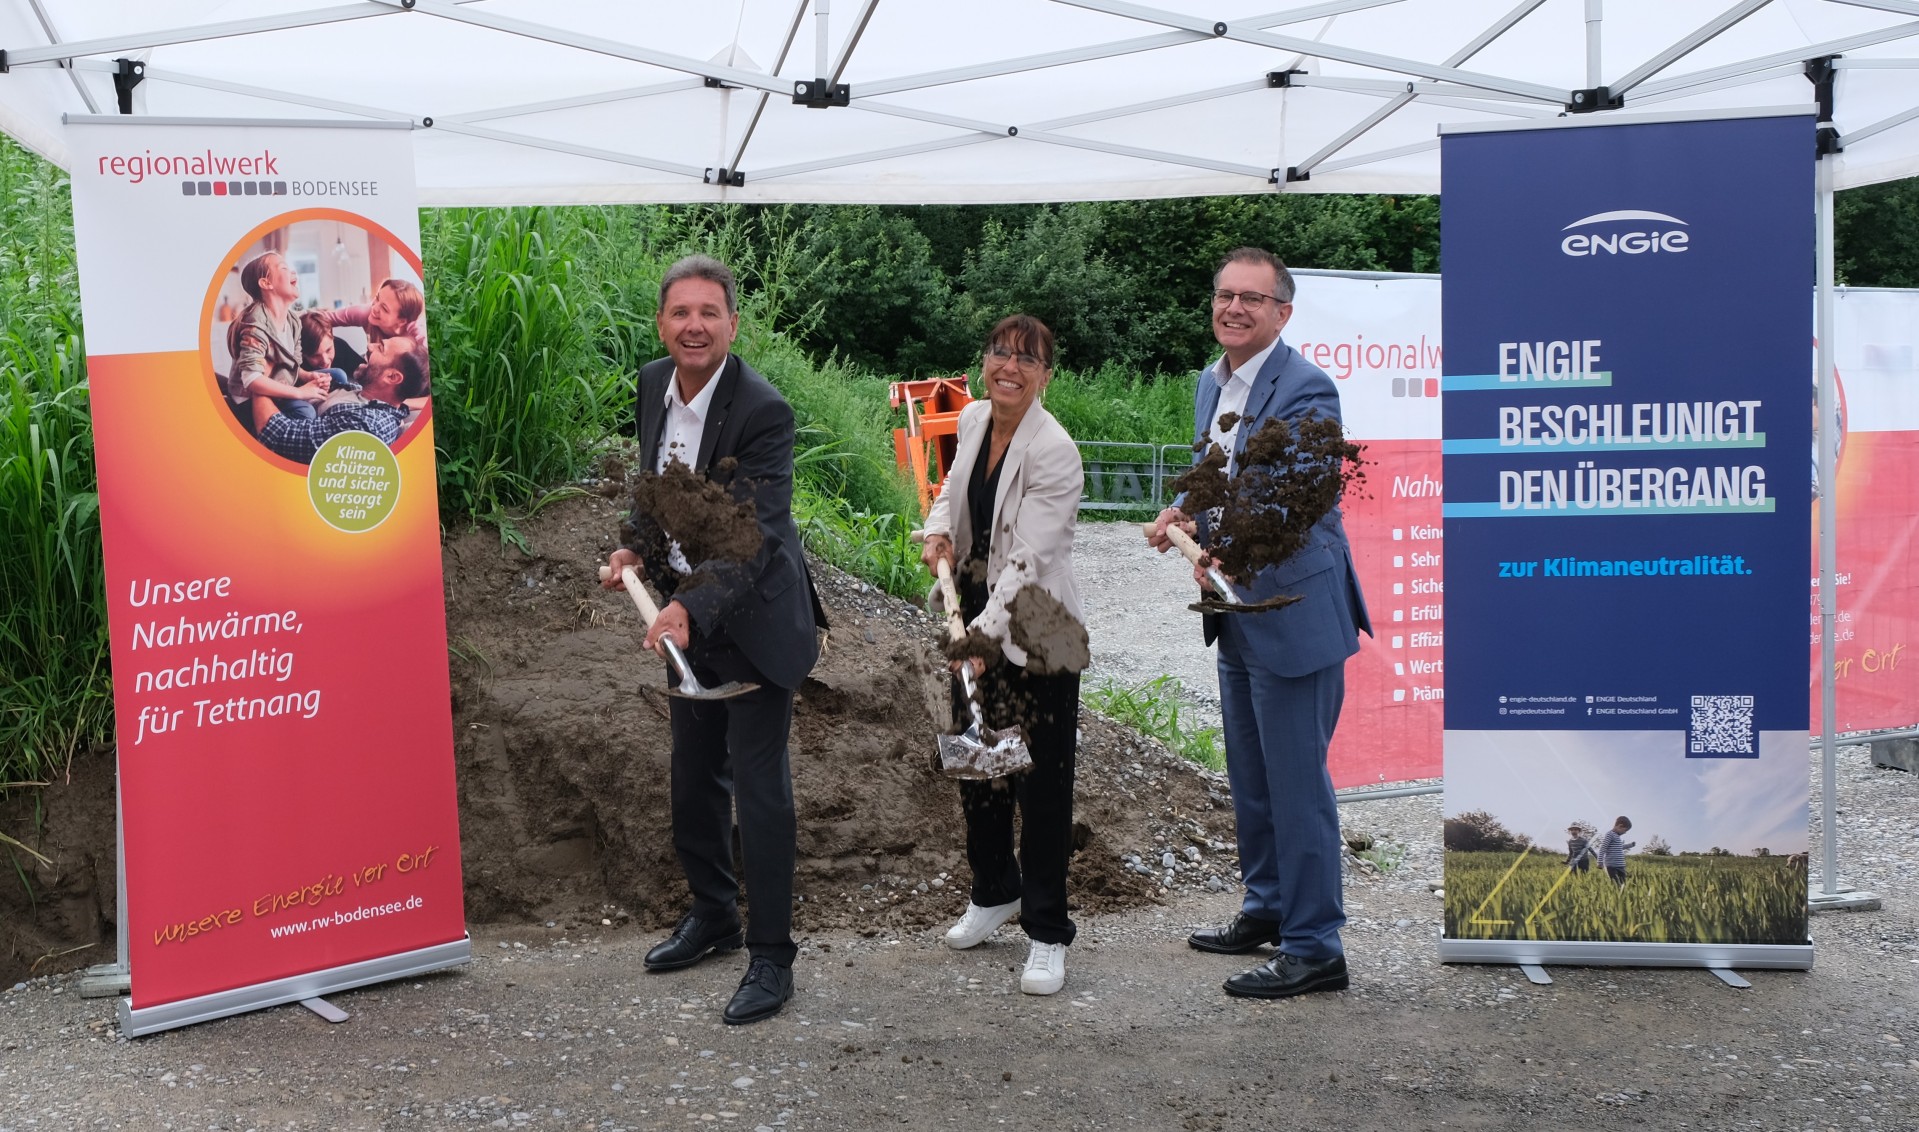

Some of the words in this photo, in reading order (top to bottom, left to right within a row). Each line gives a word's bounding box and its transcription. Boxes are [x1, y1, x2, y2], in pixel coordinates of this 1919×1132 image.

[98, 149, 279, 183] regionalwerk
[292, 180, 379, 196] BODENSEE
[1499, 339, 1602, 382] ENGIE
[1499, 400, 1762, 446] BESCHLEUNIGT
[336, 446, 376, 461] Klima
[325, 460, 385, 476] schützen
[318, 475, 347, 489] und
[350, 476, 390, 491] sicher
[1499, 469, 1568, 511] DEN
[1574, 461, 1766, 509] ÜBERGANG
[325, 492, 382, 509] versorgt
[339, 505, 366, 519] sein
[1411, 551, 1440, 567] Sehr
[1498, 560, 1538, 578] zur
[1544, 555, 1753, 577] Klimaneutralität.
[129, 576, 231, 607] Unsere
[131, 609, 303, 650] Nahwärme,
[1410, 659, 1443, 675] Wert
[1862, 643, 1906, 672] Ort
[135, 648, 294, 693] nachhaltig
[1509, 695, 1577, 704] engie-deutschland.de
[1596, 695, 1616, 703] ENGIE
[1617, 695, 1657, 703] Deutschland
[134, 706, 184, 745] für
[193, 689, 321, 728] Tettnang
[1509, 707, 1565, 716] engiedeutschland
[1596, 707, 1616, 715] ENGIE
[1617, 707, 1657, 715] Deutschland
[1658, 707, 1679, 715] GmbH
[253, 873, 345, 918] Energie
[396, 845, 440, 873] Ort
[270, 895, 423, 939] www.rw-bodensee.de
